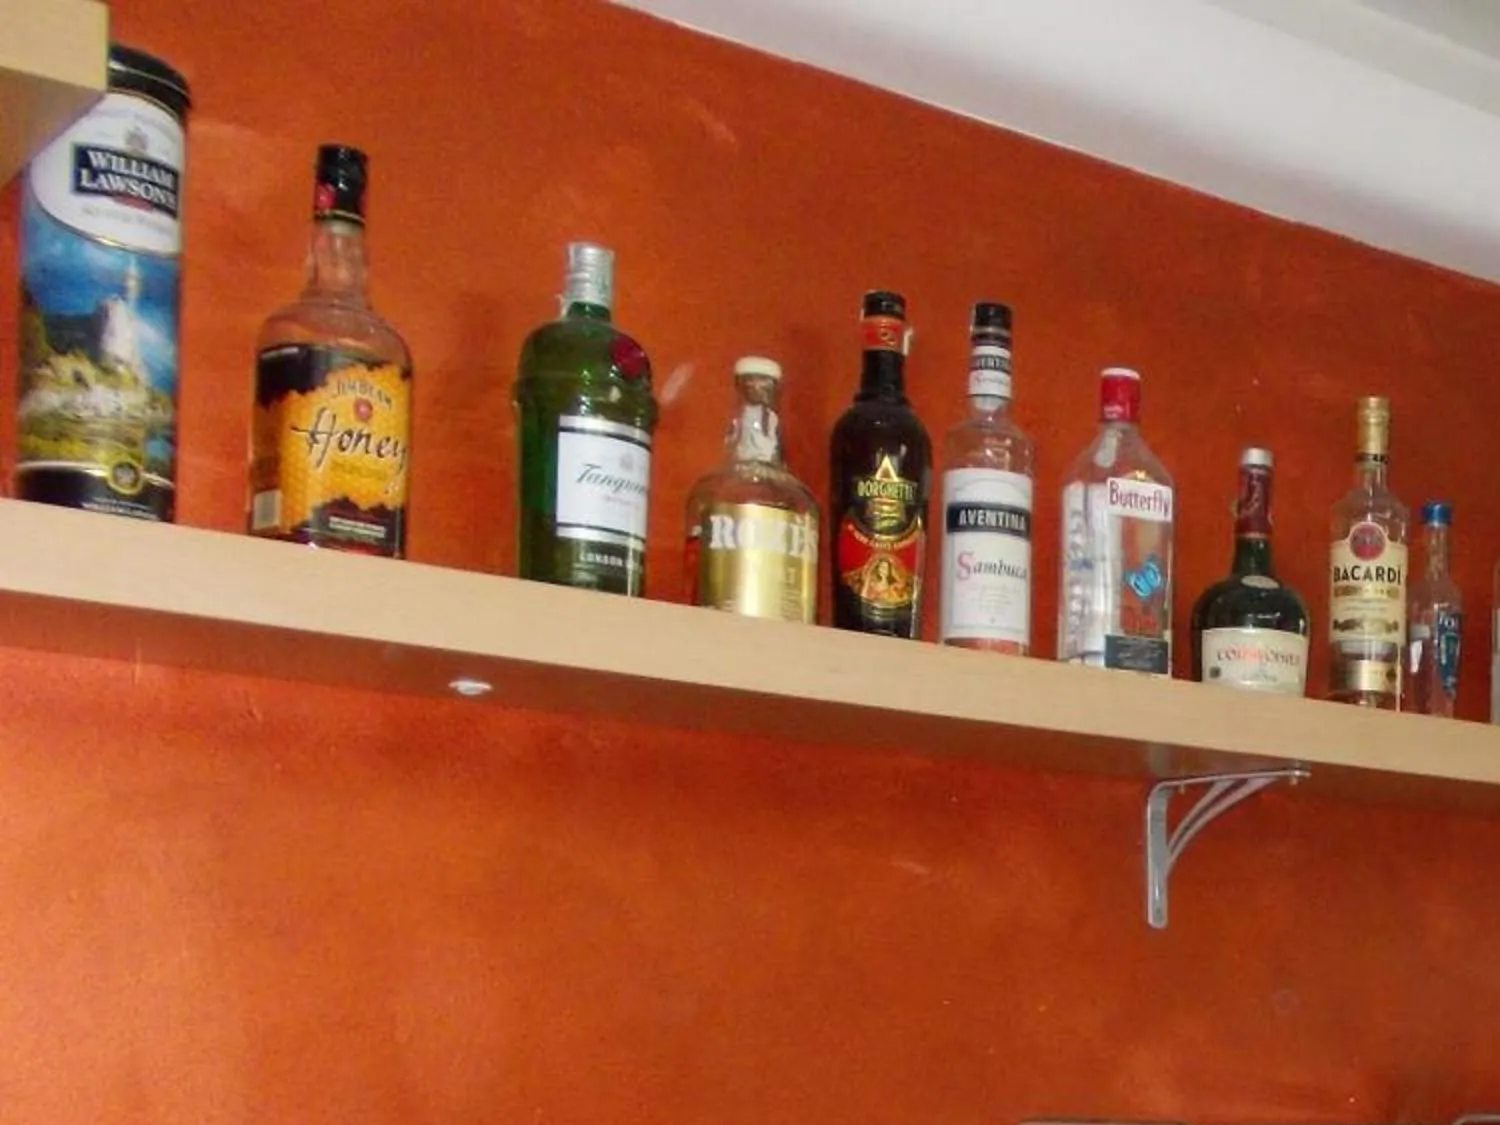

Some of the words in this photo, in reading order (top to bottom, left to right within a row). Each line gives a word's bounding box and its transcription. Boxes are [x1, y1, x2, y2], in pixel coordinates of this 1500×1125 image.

[1109, 479, 1170, 518] Butterfly
[958, 508, 1026, 531] AVENTINA
[956, 550, 1027, 581] Sambuca
